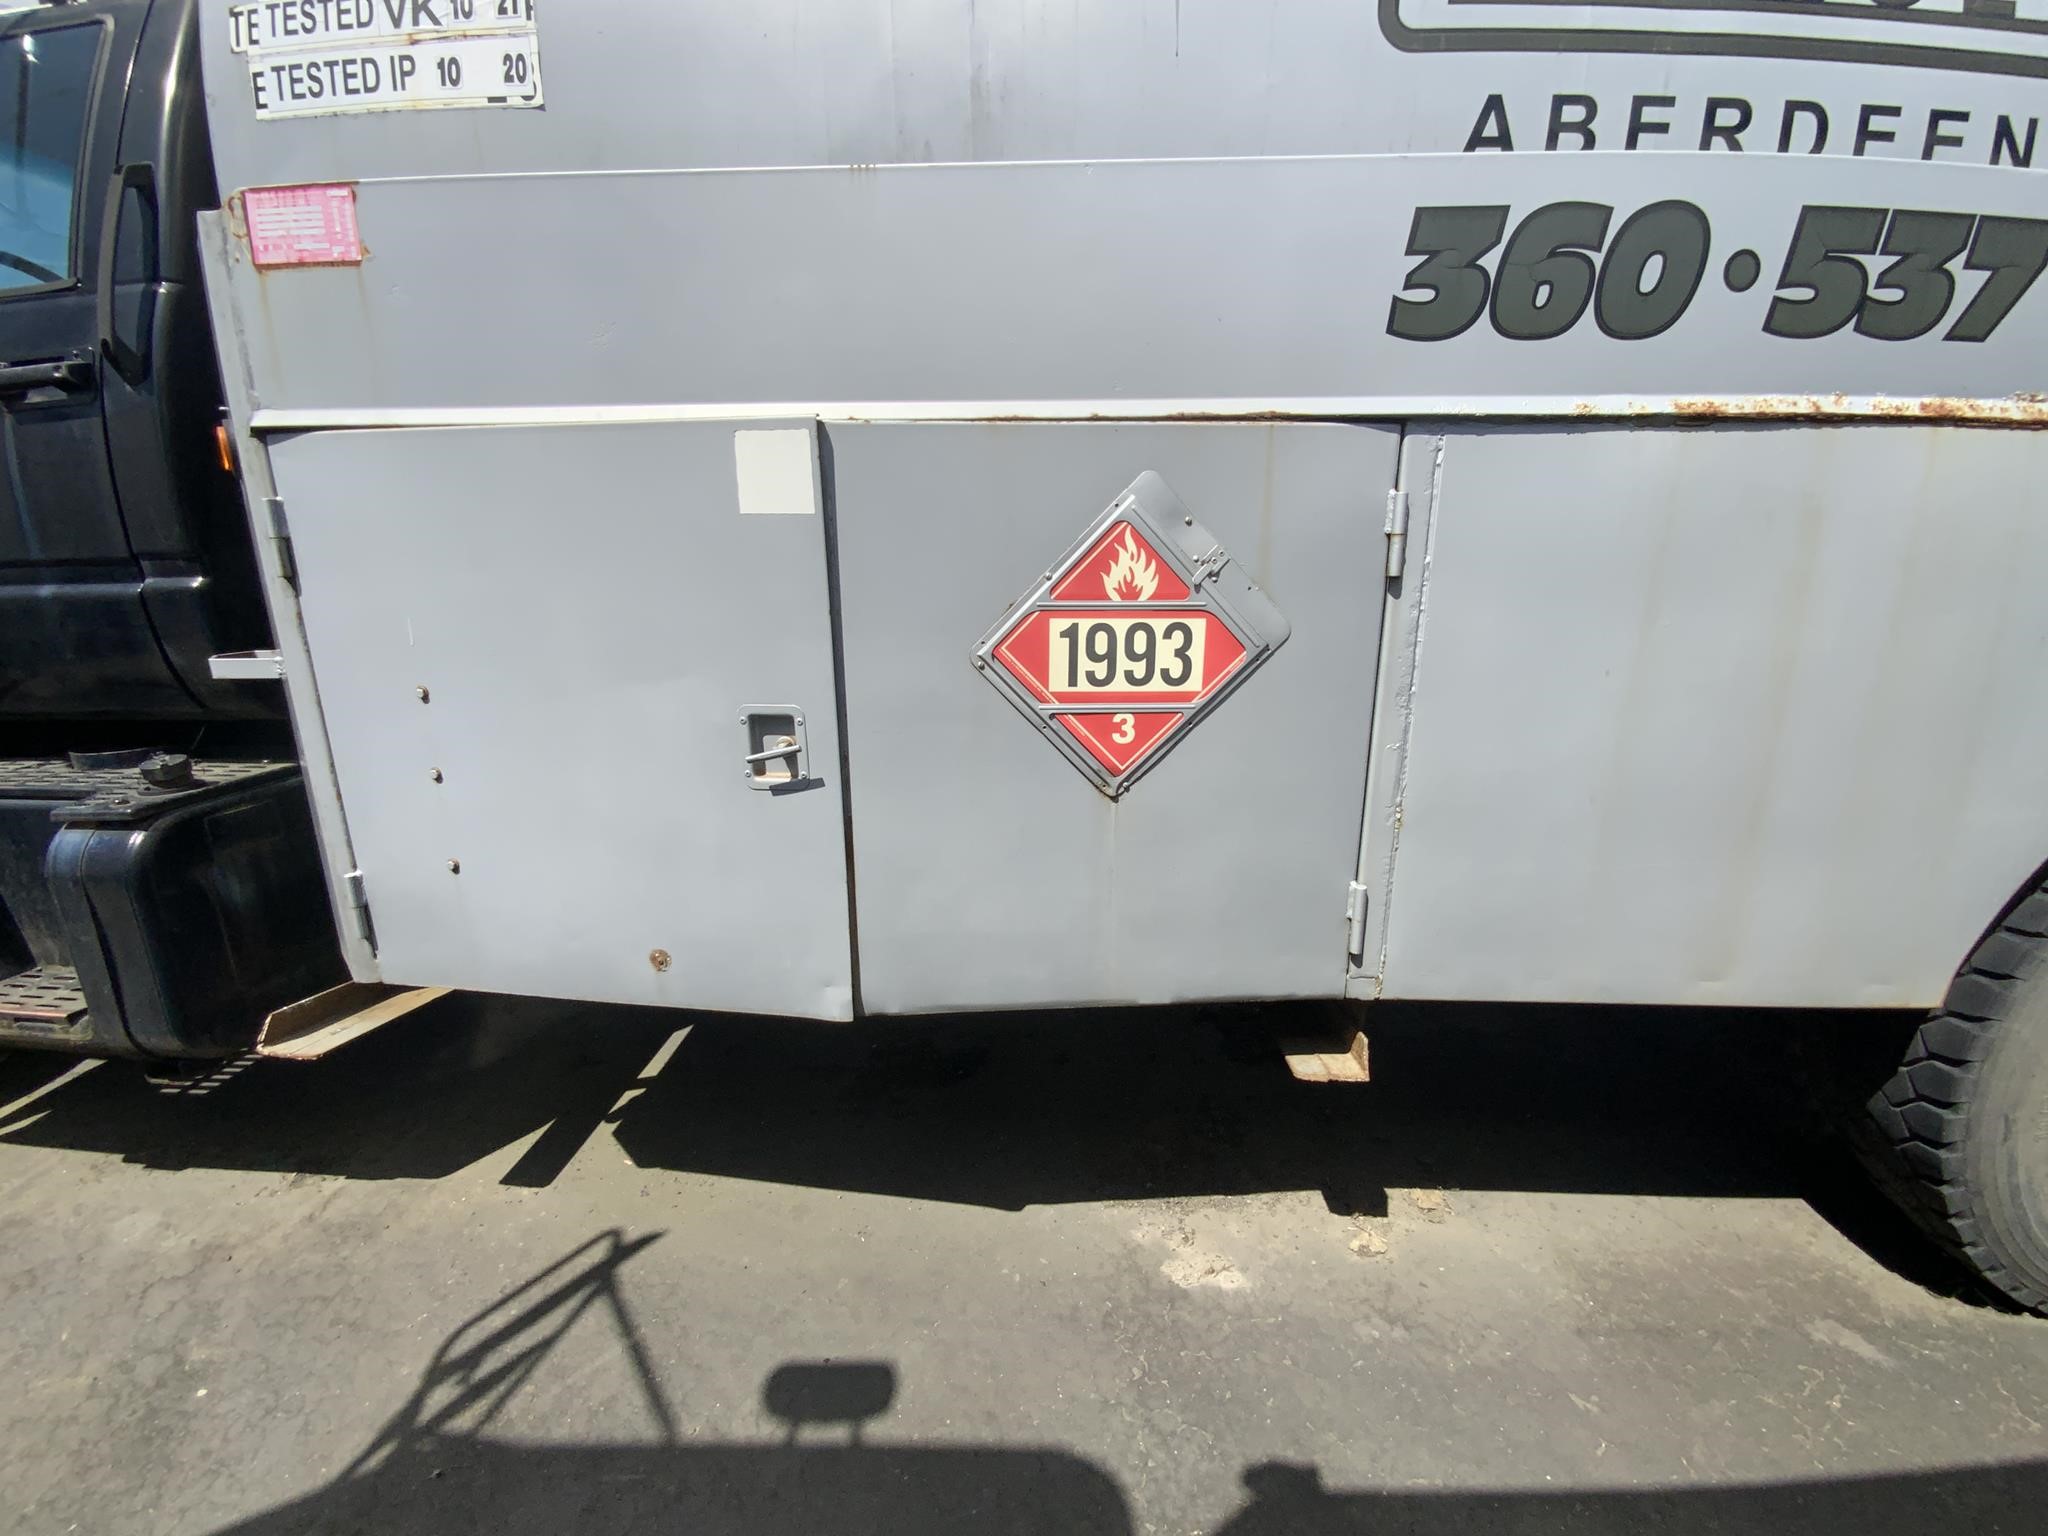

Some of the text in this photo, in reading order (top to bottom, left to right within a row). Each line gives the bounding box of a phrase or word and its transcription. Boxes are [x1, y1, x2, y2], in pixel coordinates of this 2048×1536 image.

[265, 0, 374, 38] TESTED
[384, 0, 443, 29] VK
[271, 57, 381, 101] TESTED
[390, 54, 416, 92] IP
[437, 57, 461, 87] 10
[502, 53, 527, 84] 20
[1463, 93, 2039, 168] ABERDEEN
[1059, 622, 1193, 687] 1993
[1111, 713, 1136, 744] 3
